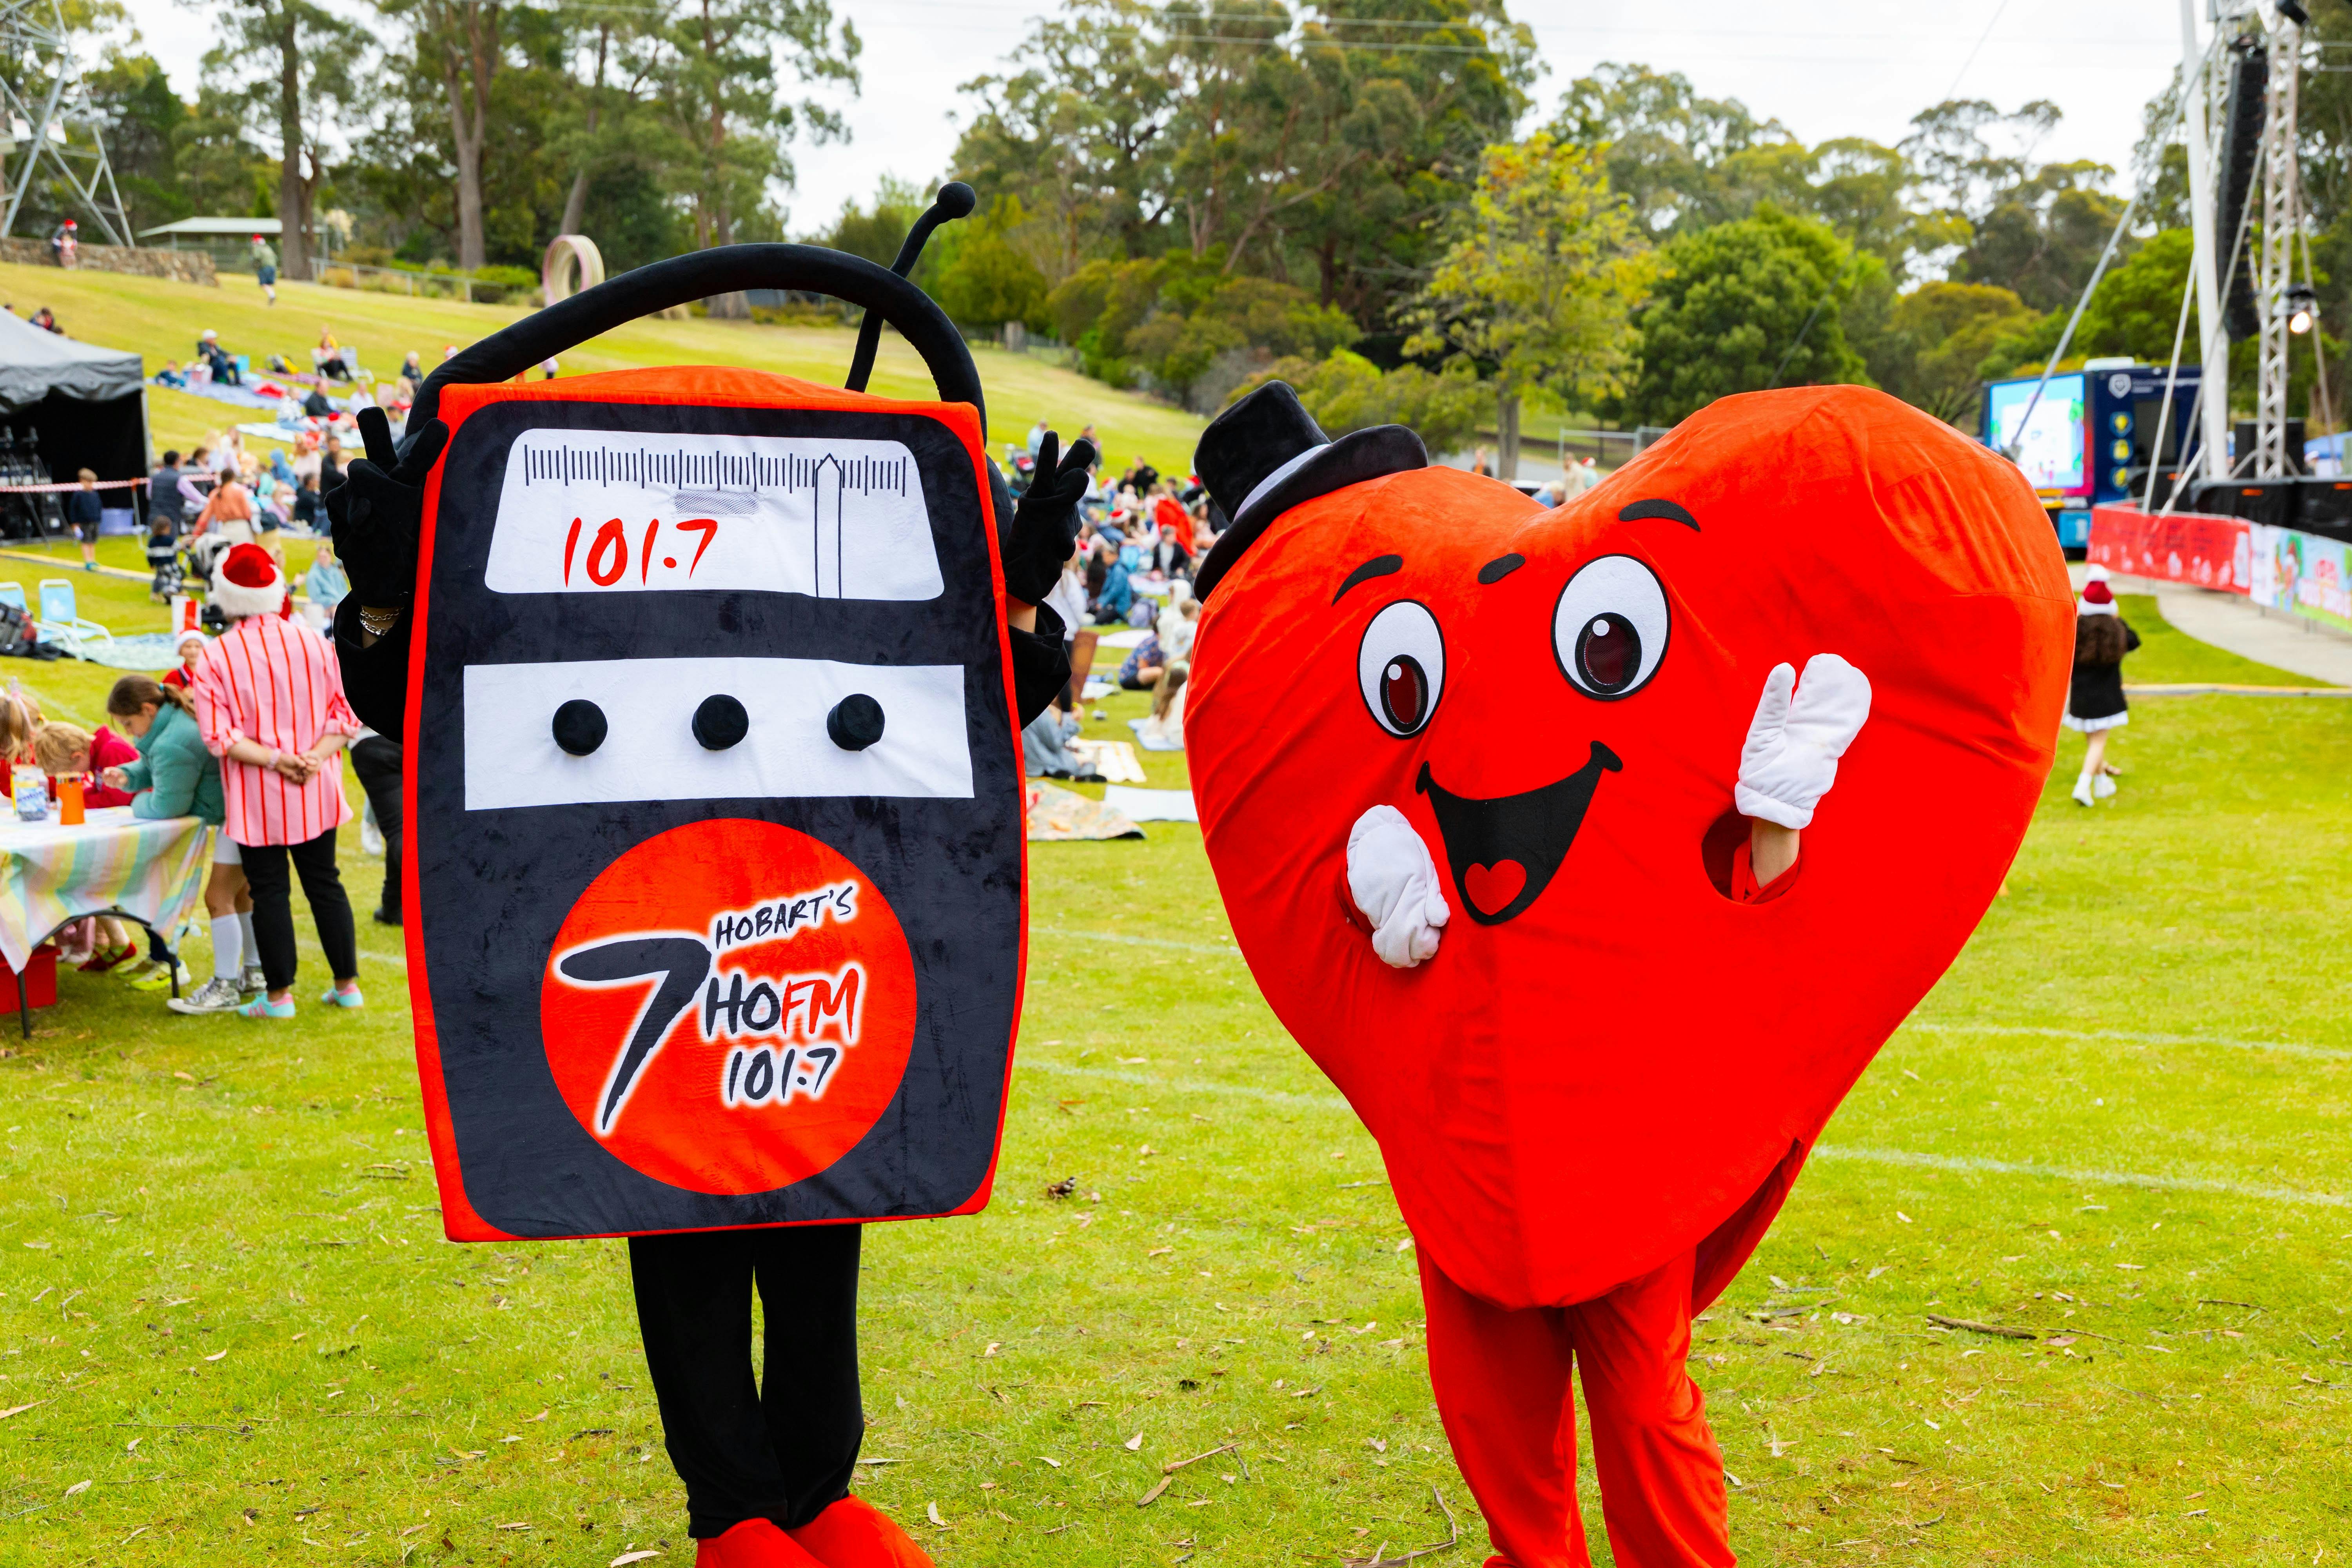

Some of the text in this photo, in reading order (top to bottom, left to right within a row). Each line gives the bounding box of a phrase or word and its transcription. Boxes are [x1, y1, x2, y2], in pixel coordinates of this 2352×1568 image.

[564, 517, 718, 587] 101.7
[715, 886, 853, 949] HOBART'S
[728, 1047, 837, 1102] 101.7
